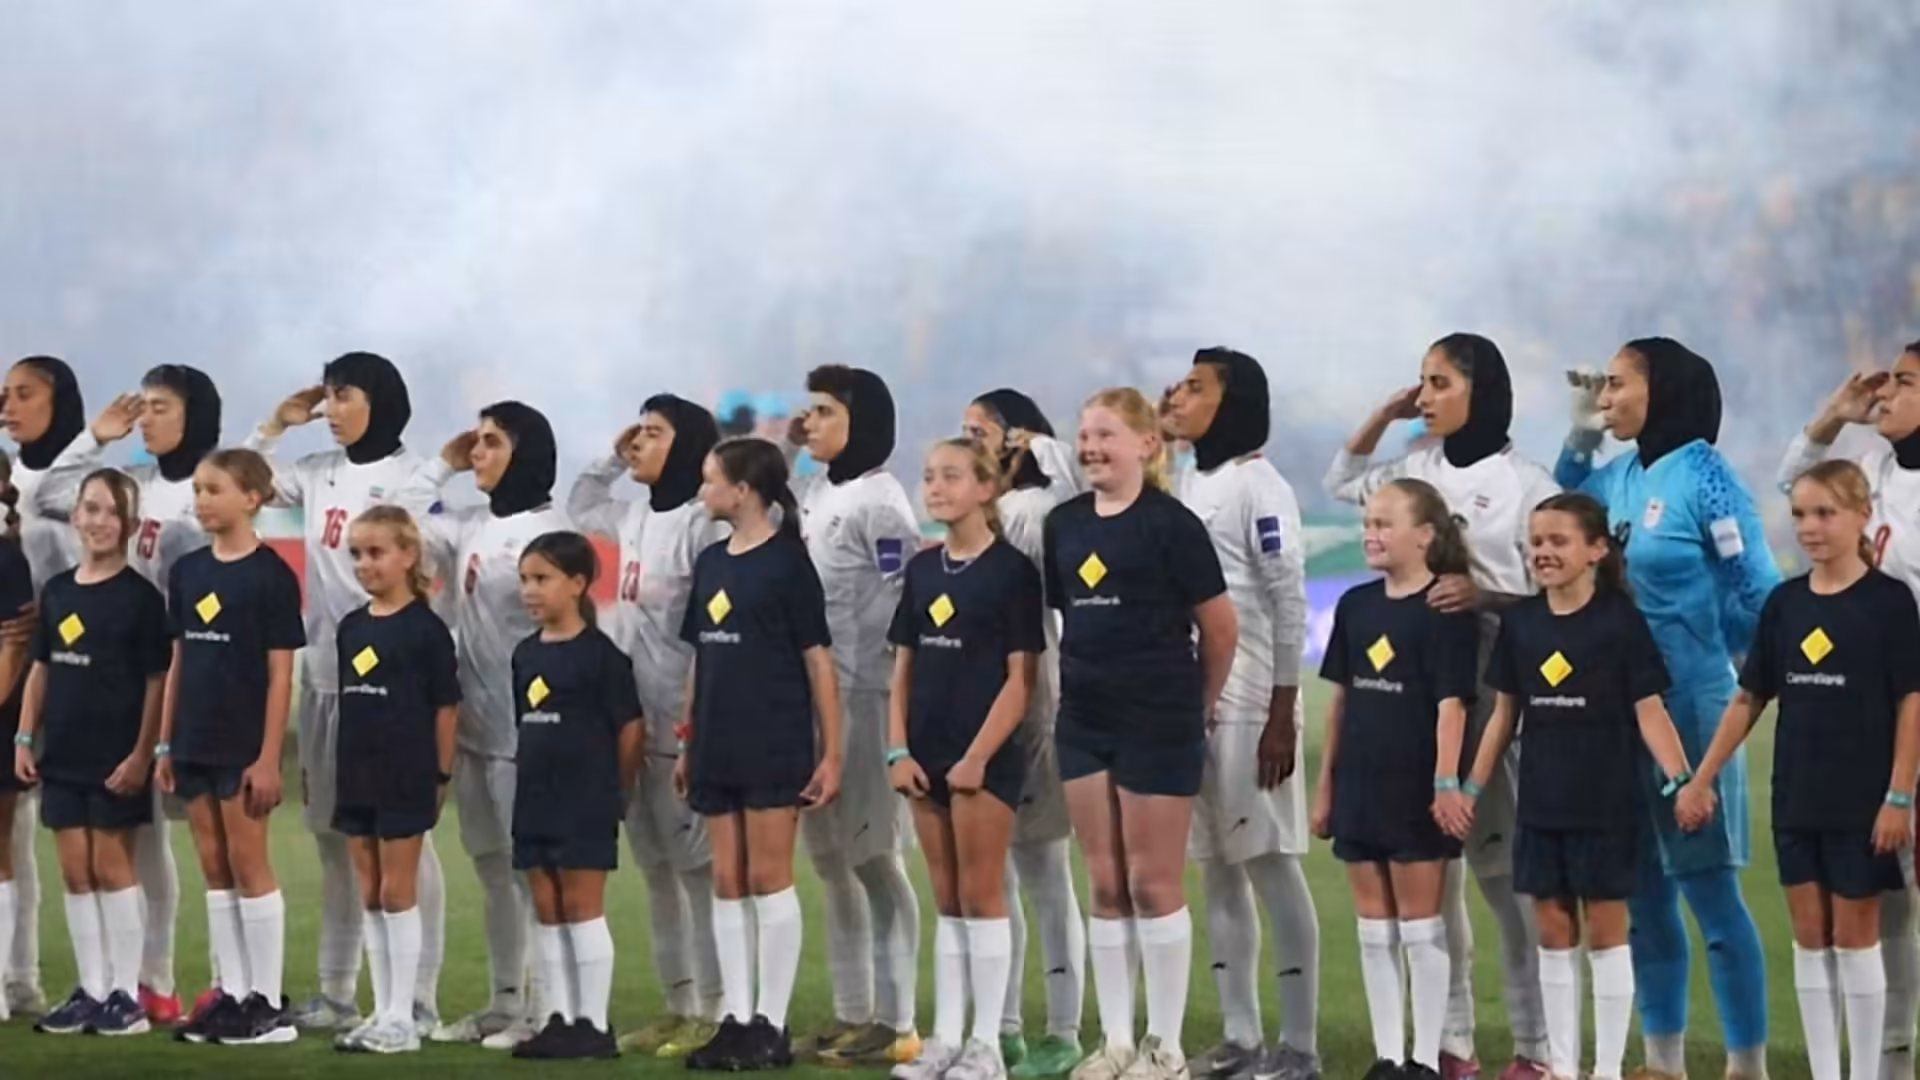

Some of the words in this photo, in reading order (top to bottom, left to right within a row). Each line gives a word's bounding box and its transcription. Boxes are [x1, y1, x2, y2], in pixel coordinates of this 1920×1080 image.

[136, 519, 161, 560] 15
[322, 518, 348, 549] 16
[1786, 671, 1847, 687] CommBank
